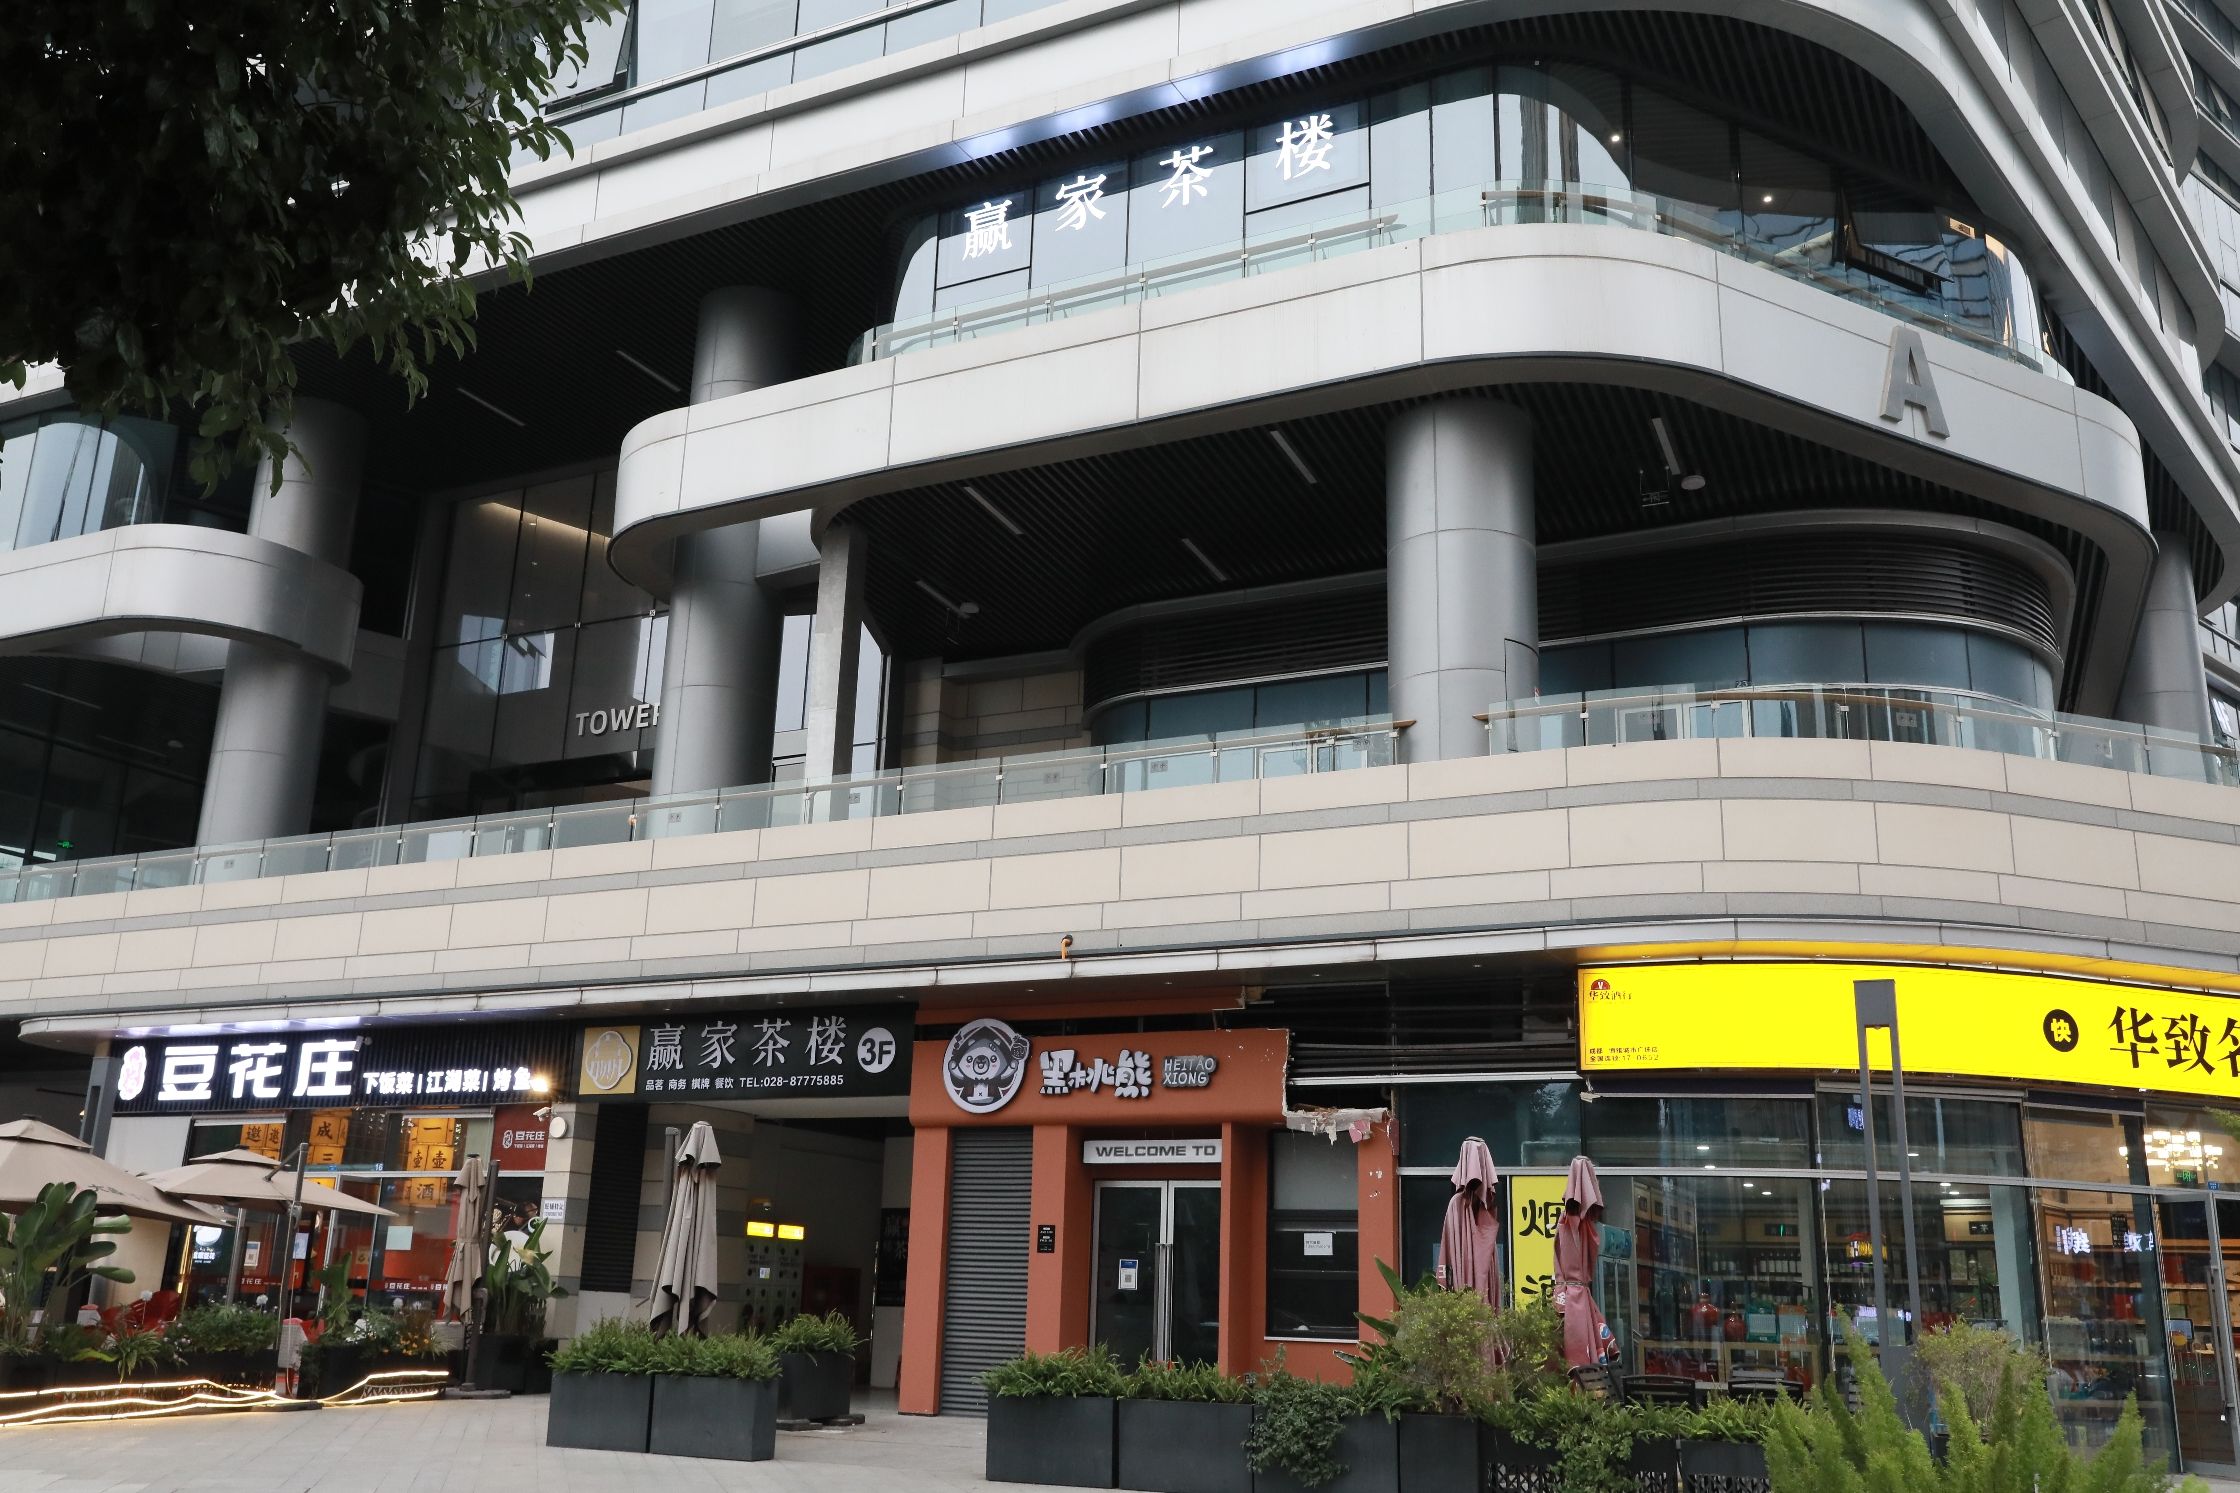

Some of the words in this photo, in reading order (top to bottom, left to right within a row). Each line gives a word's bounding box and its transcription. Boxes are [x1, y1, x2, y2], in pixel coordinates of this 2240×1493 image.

[961, 113, 1334, 262] 赢家茶楼
[1880, 325, 1950, 440] A
[647, 1015, 847, 1071] 赢家茶楼
[2051, 1018, 2071, 1043] 快
[861, 1037, 893, 1066] 3F
[1164, 1057, 1215, 1072] HEITAO
[158, 1039, 356, 1100] 豆花庄
[646, 1079, 664, 1091] 品茗
[668, 1078, 687, 1090] 商务
[691, 1077, 711, 1090] 棋牌
[715, 1077, 734, 1089] 餐饮
[740, 1075, 844, 1088] TEL:028-87775885
[1040, 1050, 1152, 1098] 黑桃熊
[1163, 1071, 1207, 1085] XIONG
[515, 1131, 546, 1141] 豆花庄
[1096, 1145, 1187, 1157] WELCOME
[1191, 1145, 1216, 1156] TO
